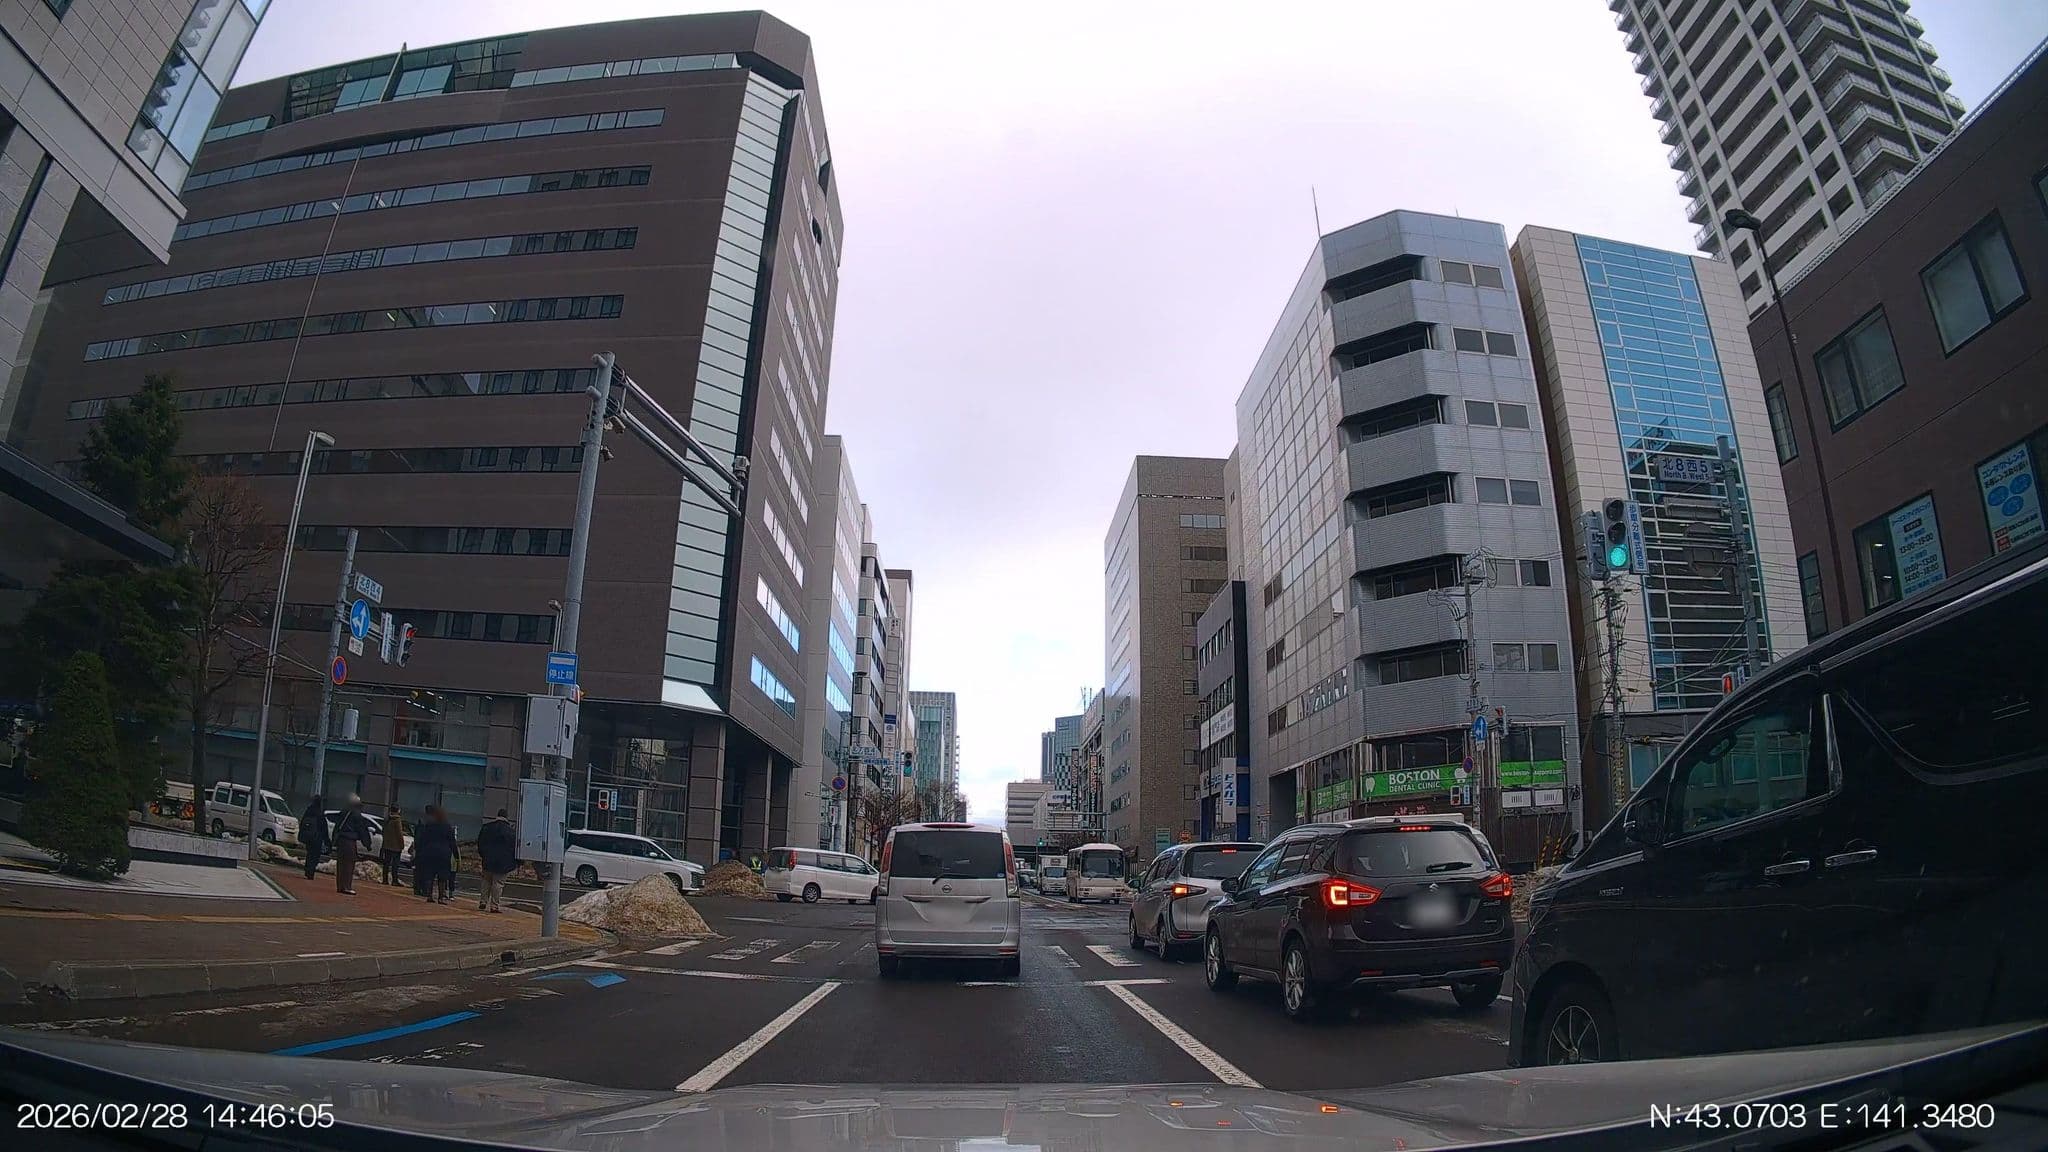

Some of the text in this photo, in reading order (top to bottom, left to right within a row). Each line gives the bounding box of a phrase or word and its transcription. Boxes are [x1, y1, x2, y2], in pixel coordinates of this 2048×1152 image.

[1662, 457, 1708, 473] 北8西5
[1664, 470, 1681, 478] North
[549, 668, 574, 680] 停止線
[1389, 769, 1440, 785] BOSTON
[1223, 773, 1235, 806] ドスパラ
[1389, 781, 1441, 793] DENTAL CLINIC
